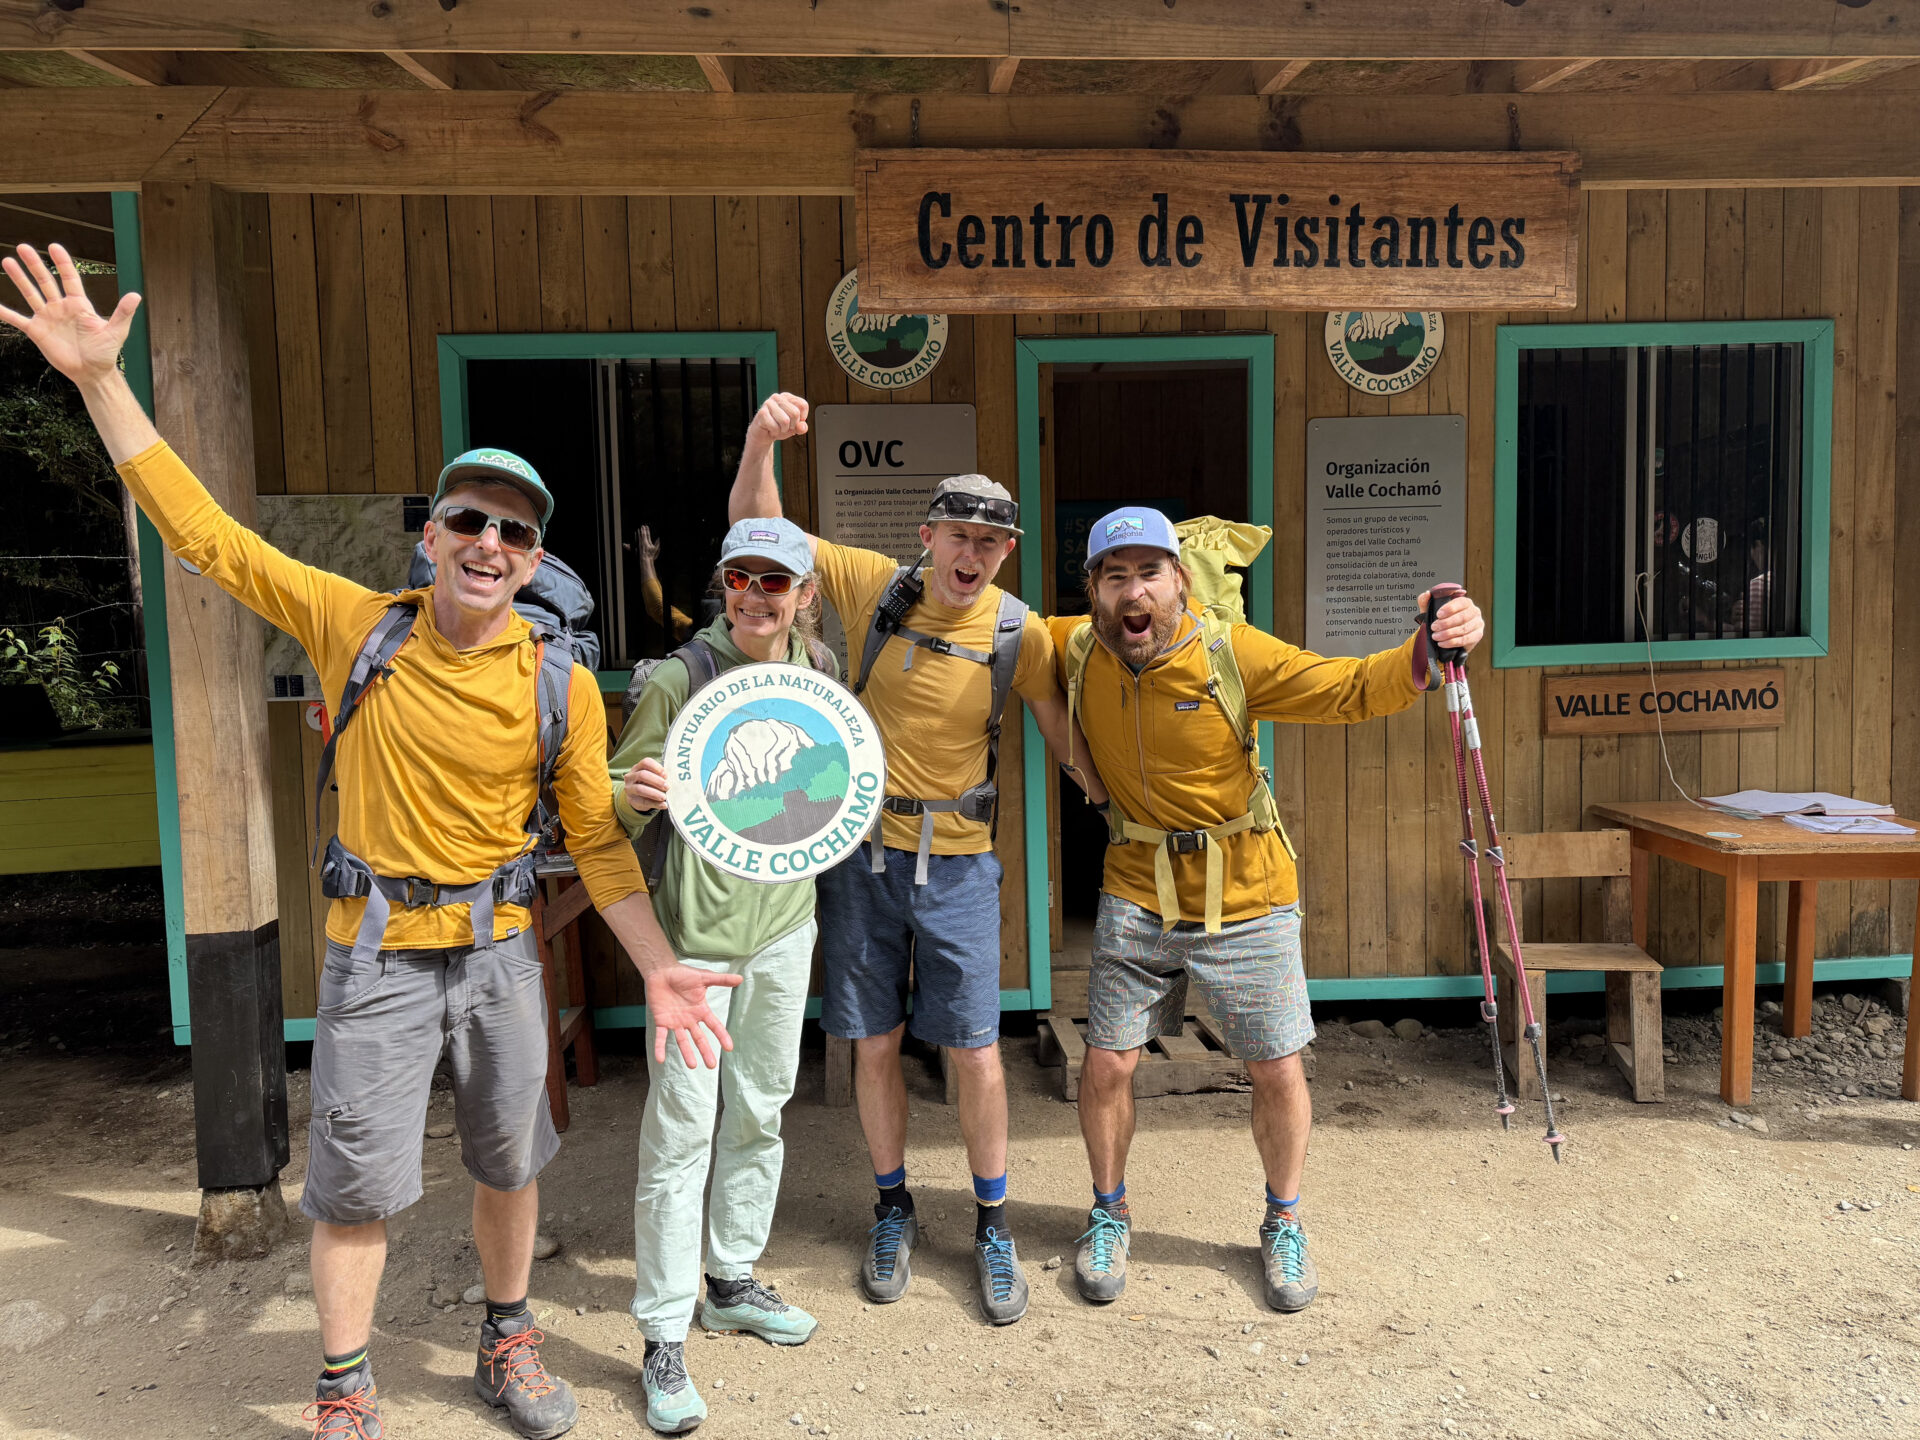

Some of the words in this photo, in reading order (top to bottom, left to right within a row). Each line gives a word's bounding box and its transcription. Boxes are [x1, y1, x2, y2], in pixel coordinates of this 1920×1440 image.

[917, 191, 1114, 269] Centro
[1138, 193, 1204, 268] de
[1229, 193, 1526, 269] Visitantes
[834, 274, 858, 316] SANTUA
[831, 331, 869, 379] VALLE
[869, 340, 942, 385] COCHAMÓ
[1330, 340, 1365, 387] VALLE
[1366, 346, 1438, 392] COCHAMÓ
[839, 440, 904, 468] OVC
[1326, 458, 1430, 479] Organización
[844, 487, 884, 497] Organización
[902, 486, 931, 495] Cochamó
[1326, 483, 1364, 498] Valle
[1368, 480, 1441, 497] Cochamó
[878, 500, 892, 508] para
[893, 498, 918, 508] trabajar
[847, 509, 861, 517] Valle
[863, 508, 892, 517] Cochamó
[845, 520, 878, 528] consolidar
[1326, 516, 1351, 524] Somos
[1364, 516, 1386, 525] grupo
[1388, 514, 1397, 522] de
[1399, 514, 1429, 523] vecinos,
[878, 530, 889, 538] Sus
[891, 530, 910, 539] logros
[1326, 527, 1368, 536] operadores
[1370, 526, 1404, 534] turísticos
[1326, 539, 1353, 548] amigos
[1354, 538, 1366, 546] del
[1387, 536, 1422, 545] Cochamó
[1326, 551, 1340, 559] que
[1342, 549, 1383, 558] trabajamos
[1326, 560, 1377, 569] consolidación
[1401, 559, 1418, 567] área
[1326, 572, 1361, 582] protegida
[1363, 570, 1411, 579] colaborativa,
[1412, 570, 1436, 578] donde
[1336, 583, 1373, 592] desarrolle
[1326, 595, 1373, 605] responsable,
[1374, 594, 1417, 602] sustentable
[1332, 606, 1370, 614] sostenible
[1391, 604, 1418, 613] tiempo
[1326, 617, 1373, 626] conservando
[1325, 629, 1366, 638] patrimonio
[1555, 693, 1631, 717] VALLE
[1639, 681, 1779, 715] COCHAMÓ
[678, 690, 727, 781] SANTUARIO
[728, 679, 751, 697] DE
[753, 674, 776, 688] LA
[779, 674, 865, 748] NATURALEZA
[682, 804, 763, 873] VALLE
[769, 771, 878, 875] COCHAMÓ
